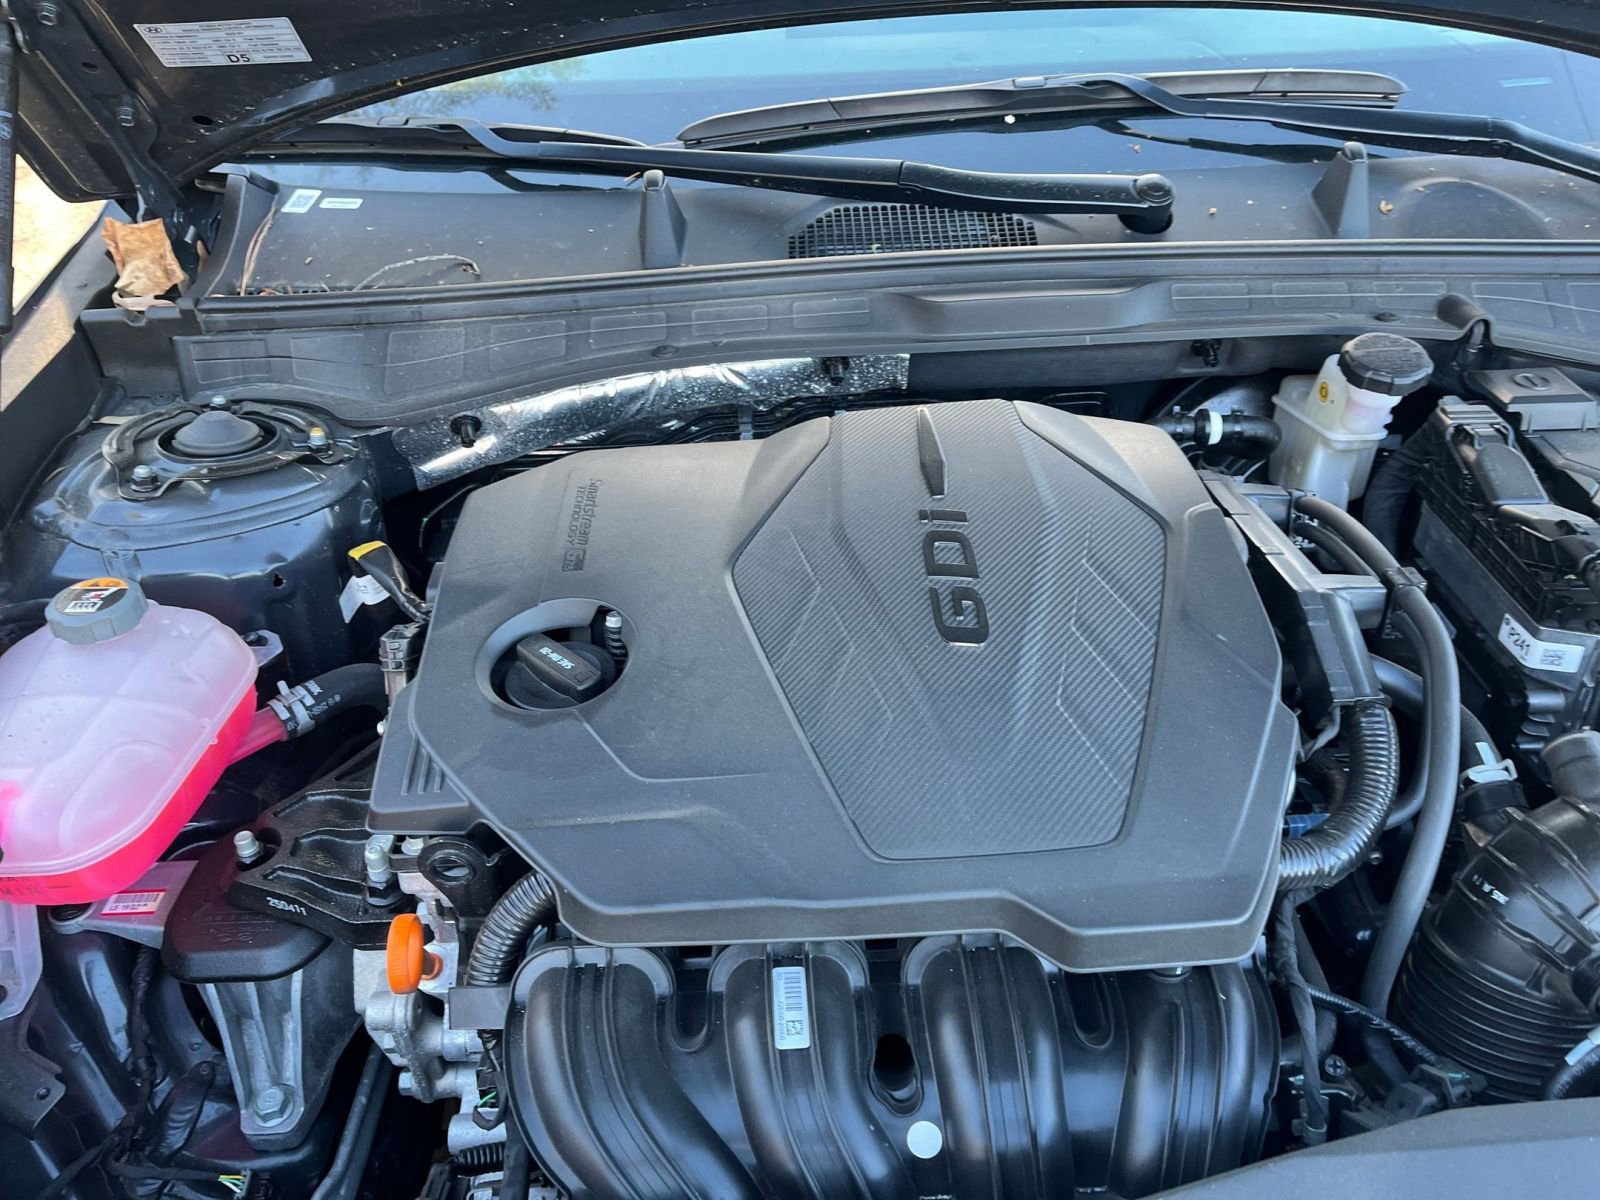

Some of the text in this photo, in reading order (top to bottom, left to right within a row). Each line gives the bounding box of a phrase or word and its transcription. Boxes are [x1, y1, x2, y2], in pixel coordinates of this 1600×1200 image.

[227, 54, 251, 63] D5
[576, 478, 603, 546] Smartstream
[918, 508, 990, 645] GDi
